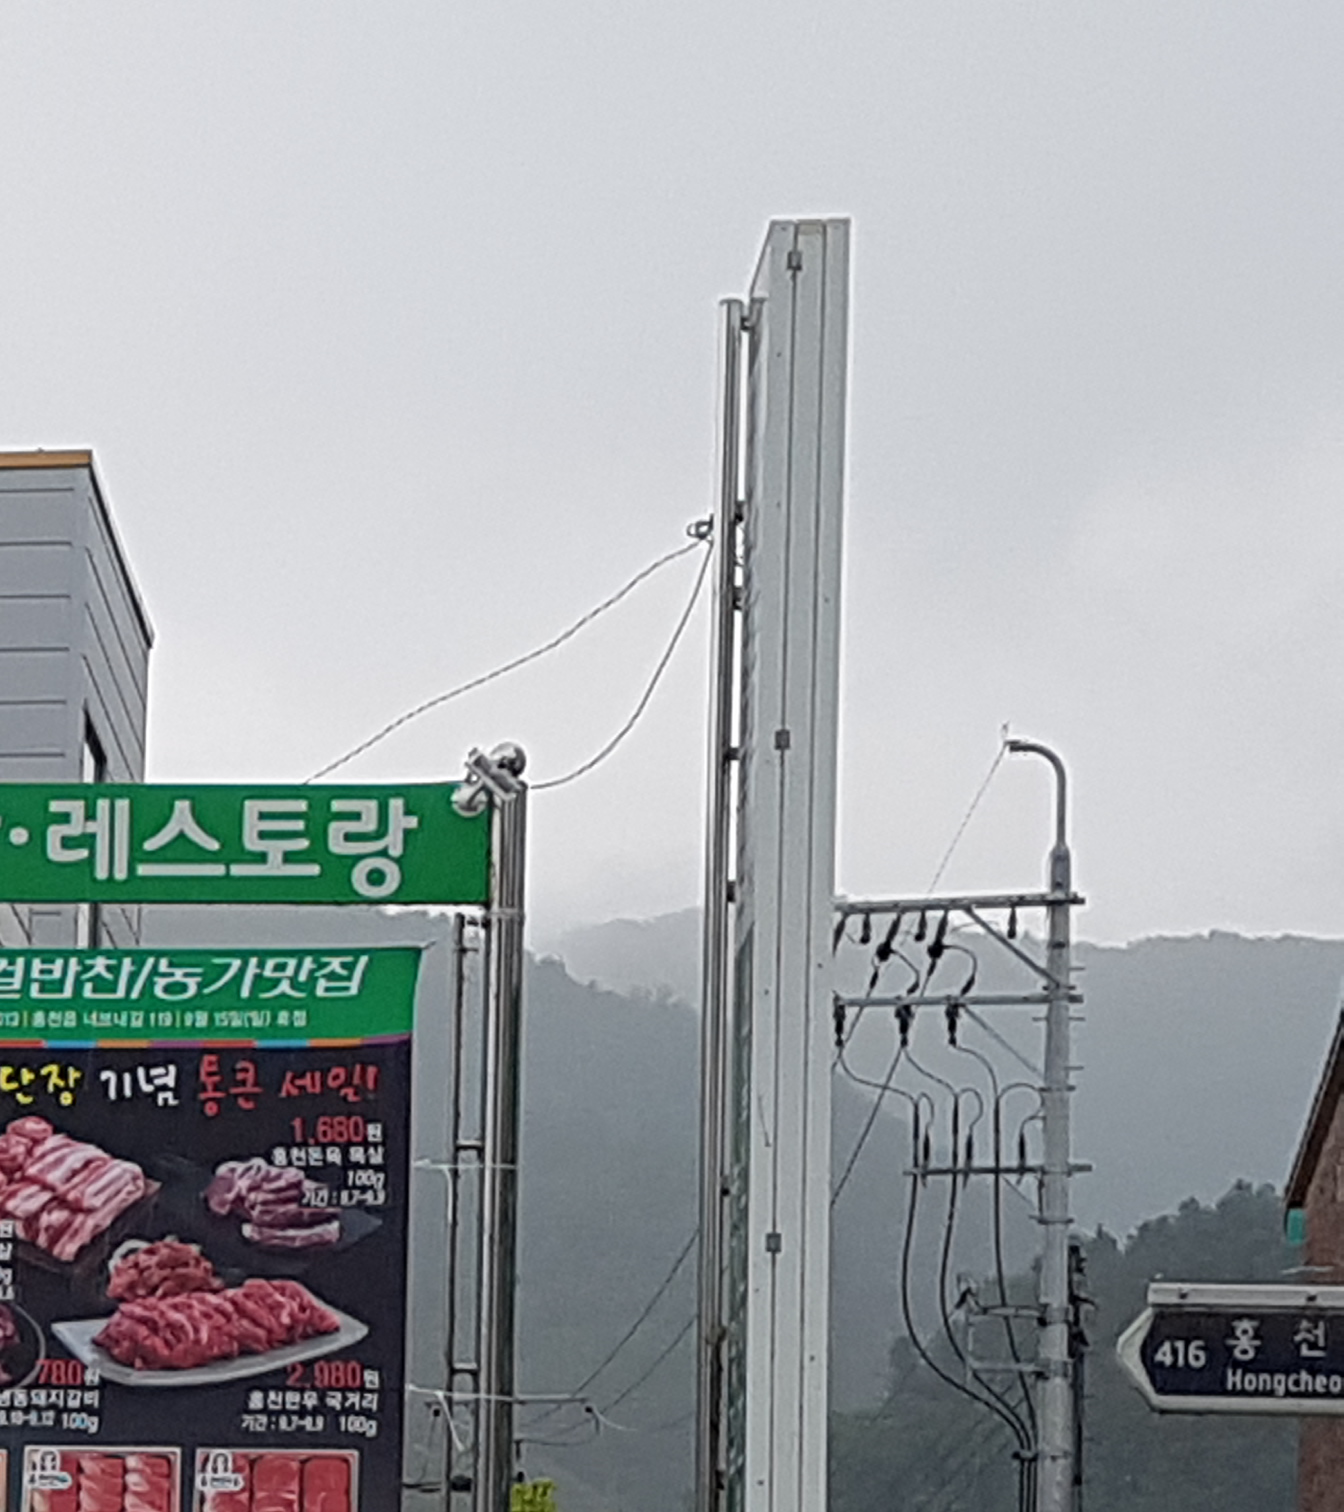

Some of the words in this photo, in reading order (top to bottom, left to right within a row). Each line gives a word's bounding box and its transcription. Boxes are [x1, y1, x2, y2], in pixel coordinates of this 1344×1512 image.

[99, 1064, 179, 1106] 기념
[198, 1056, 263, 1116] 통큰
[290, 1115, 382, 1145] 1,680원
[347, 1169, 385, 1190] 100g
[1153, 1340, 1207, 1368] 416
[36, 1358, 101, 1387] 780원
[285, 1360, 379, 1389] 2,980원
[1226, 1367, 1344, 1397] Hongcheo
[325, 1390, 379, 1412] 국거리
[62, 1412, 99, 1434] 100g
[339, 1415, 378, 1438] 100g
